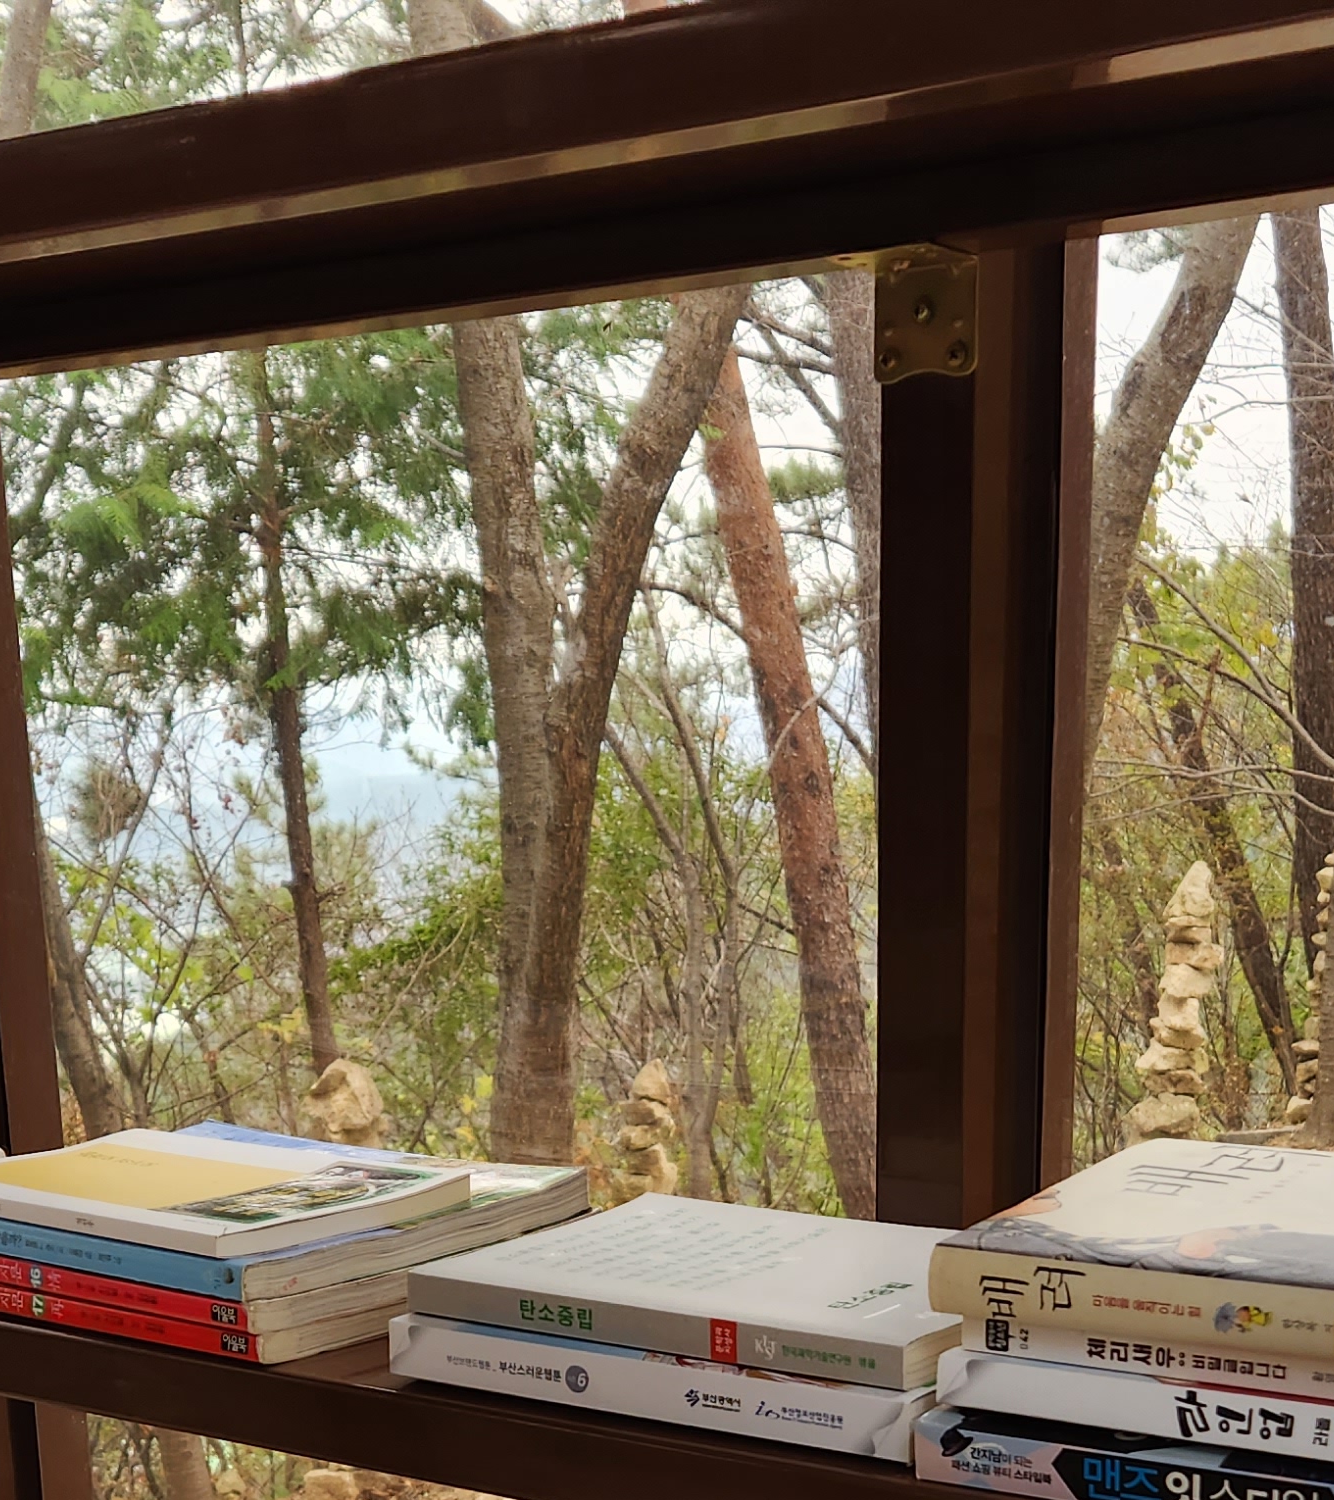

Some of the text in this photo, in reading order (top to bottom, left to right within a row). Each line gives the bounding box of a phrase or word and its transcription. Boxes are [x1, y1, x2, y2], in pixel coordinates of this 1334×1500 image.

[1124, 1144, 1333, 1200] 배려
[29, 1266, 43, 1288] 16
[827, 1282, 914, 1309] 탄소중립
[979, 1266, 1087, 1320] 배려
[1092, 1294, 1130, 1309] 마음을
[212, 1305, 237, 1324] 아울북
[520, 1299, 593, 1330] 탄소중립
[222, 1333, 248, 1354] 아울북
[498, 1361, 562, 1383] 부산스러운웹툰
[1192, 1353, 1288, 1380] 비밀글입니다
[1173, 1389, 1295, 1439] 라인업
[970, 1447, 1012, 1466] 간지남이
[1014, 1469, 1052, 1485] 스타일북
